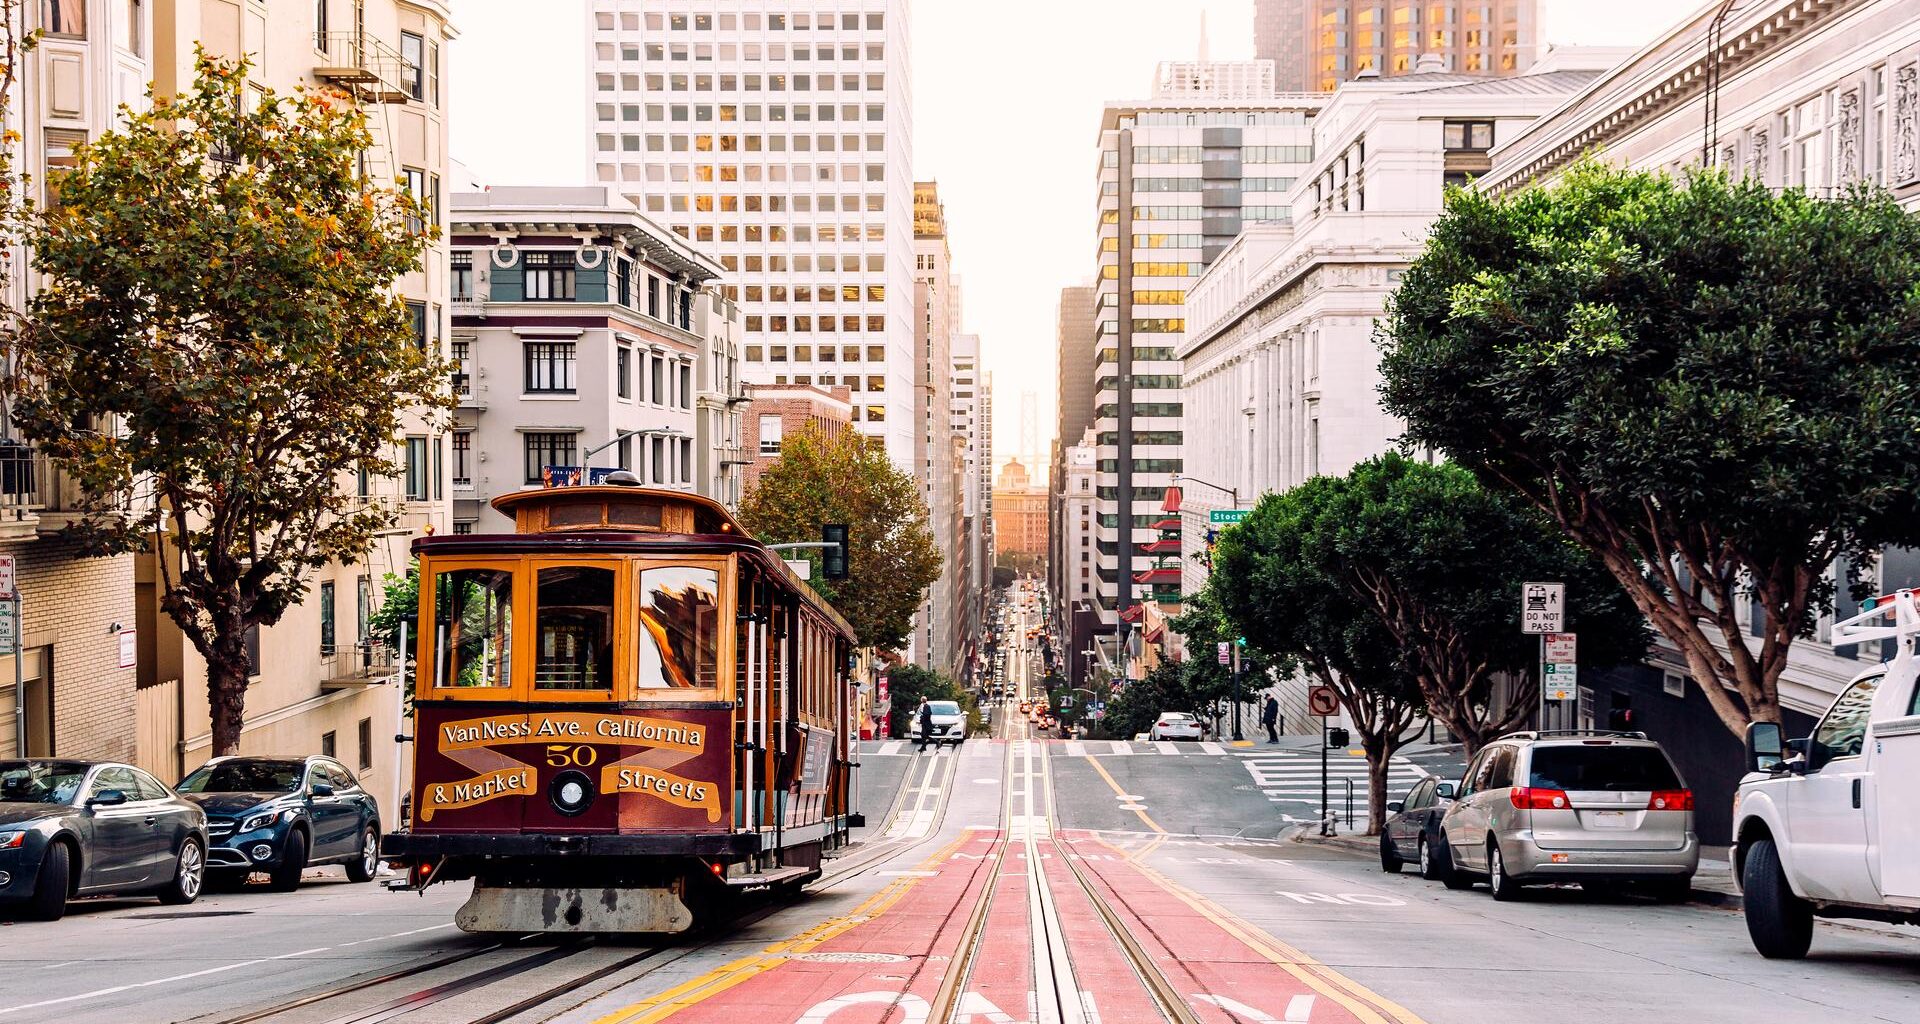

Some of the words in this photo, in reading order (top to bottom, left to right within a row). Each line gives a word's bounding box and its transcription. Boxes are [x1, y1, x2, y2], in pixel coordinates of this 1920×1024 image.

[1213, 512, 1243, 521] Stock
[1526, 612, 1539, 621] DO
[1542, 612, 1560, 621] NOT
[1531, 622, 1555, 631] PASS
[1547, 664, 1554, 673] 2
[444, 725, 479, 743] Van
[482, 720, 532, 739] Ness
[596, 718, 701, 746] California
[546, 745, 597, 767] 50
[433, 785, 449, 804] &
[454, 770, 528, 803] Market
[618, 769, 707, 801] Streets
[1273, 890, 1408, 906] NO
